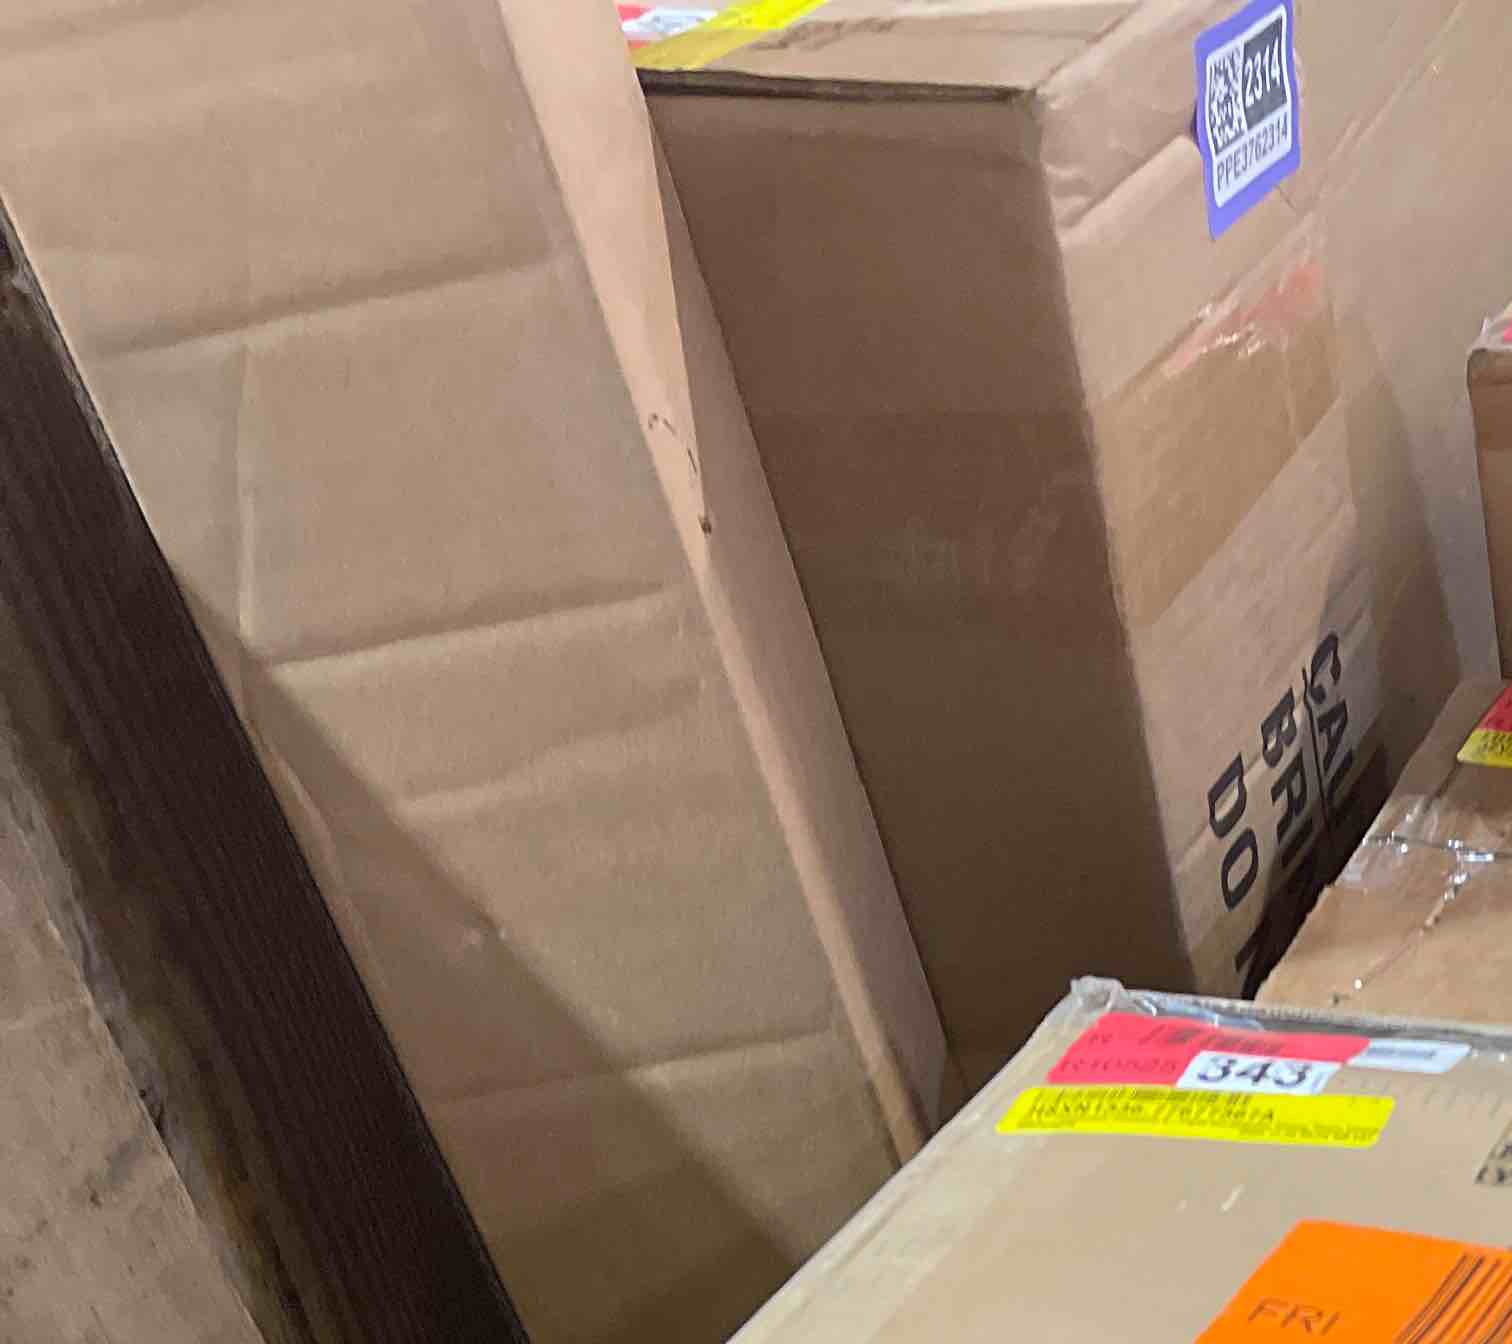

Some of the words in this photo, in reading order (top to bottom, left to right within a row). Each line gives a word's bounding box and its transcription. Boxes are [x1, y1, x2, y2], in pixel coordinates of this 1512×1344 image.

[1245, 36, 1281, 108] 2314
[1208, 751, 1259, 911] DO
[1247, 1296, 1340, 1338] FRI
